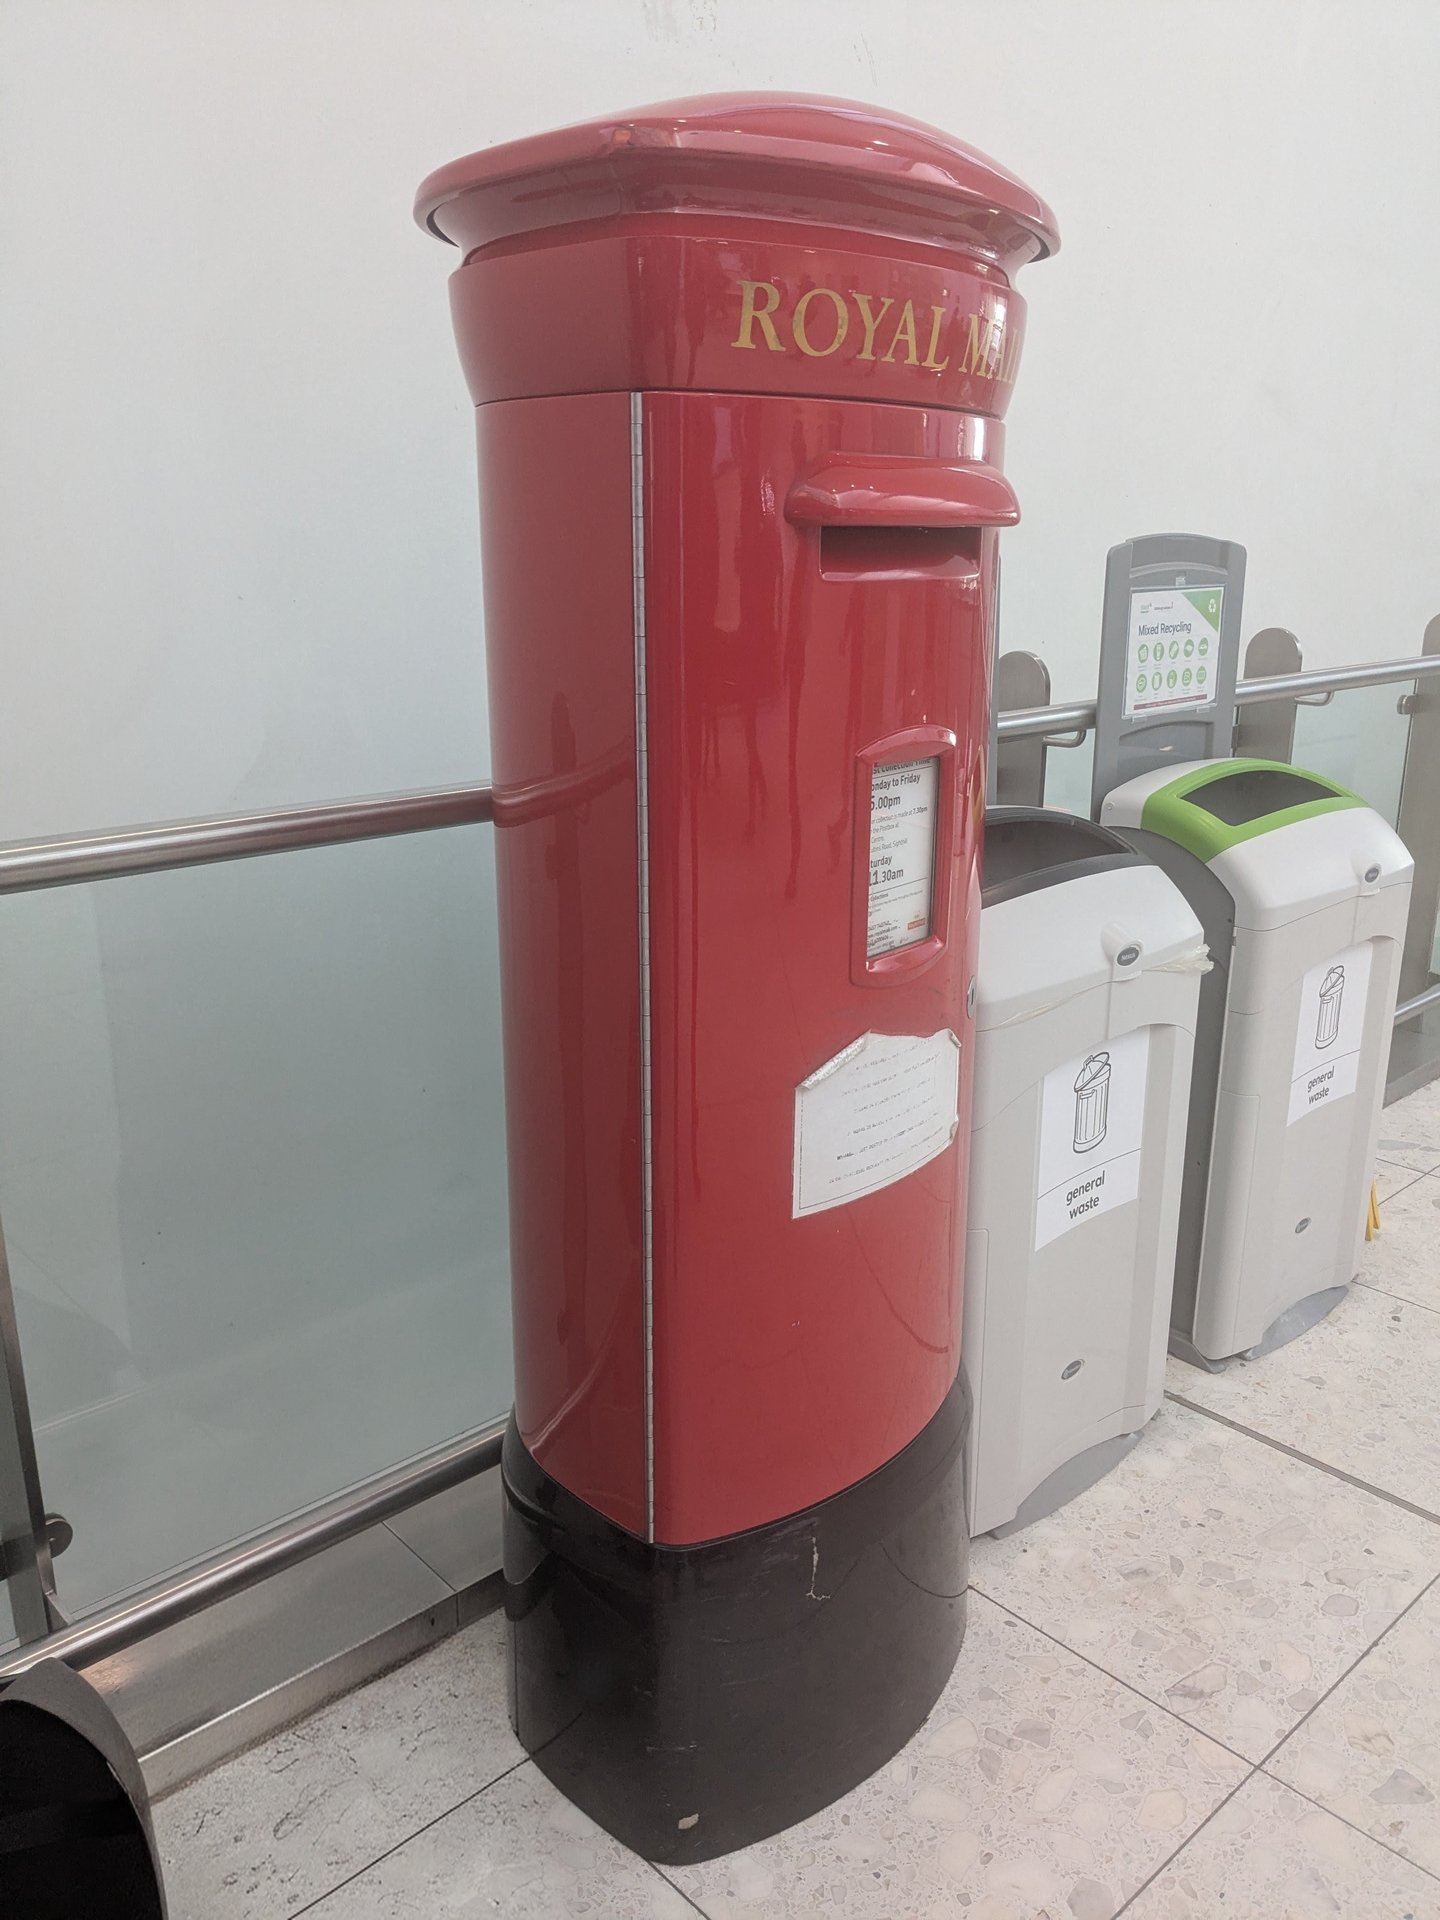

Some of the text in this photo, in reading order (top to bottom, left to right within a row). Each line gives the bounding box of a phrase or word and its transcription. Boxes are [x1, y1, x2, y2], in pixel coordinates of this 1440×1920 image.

[730, 280, 951, 369] ROYAL
[1138, 621, 1192, 637] Mixed Recycling
[892, 778, 899, 787] to
[900, 774, 920, 786] Friday
[1307, 1066, 1335, 1093] general
[1308, 1086, 1330, 1105] waste
[1066, 1170, 1105, 1207] general
[1069, 1195, 1100, 1220] waste
